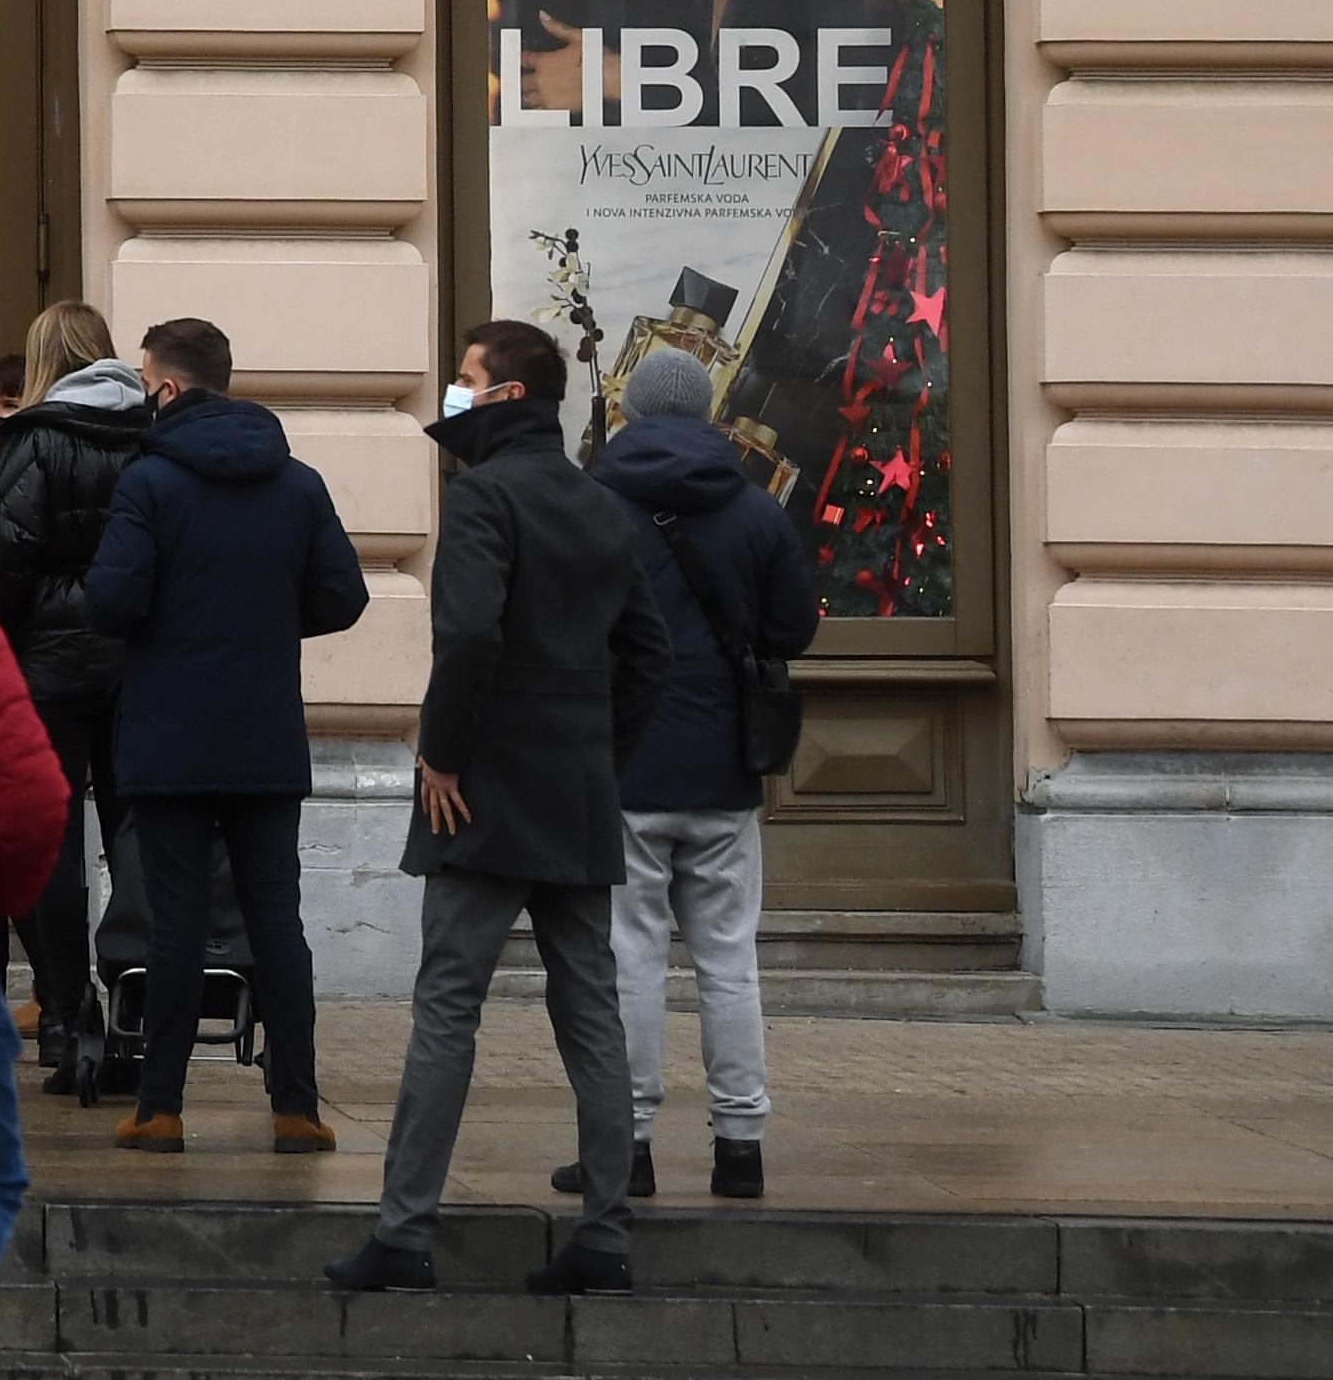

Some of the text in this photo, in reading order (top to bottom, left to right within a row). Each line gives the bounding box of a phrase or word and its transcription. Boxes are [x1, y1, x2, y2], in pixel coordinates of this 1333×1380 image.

[500, 27, 894, 128] LIBRE
[645, 193, 750, 204] PARFEMSKA VODA
[586, 208, 590, 218] I
[593, 208, 626, 218] NOVA
[630, 208, 702, 218] INTENZIVNA
[704, 208, 772, 218] PARFEMSKA
